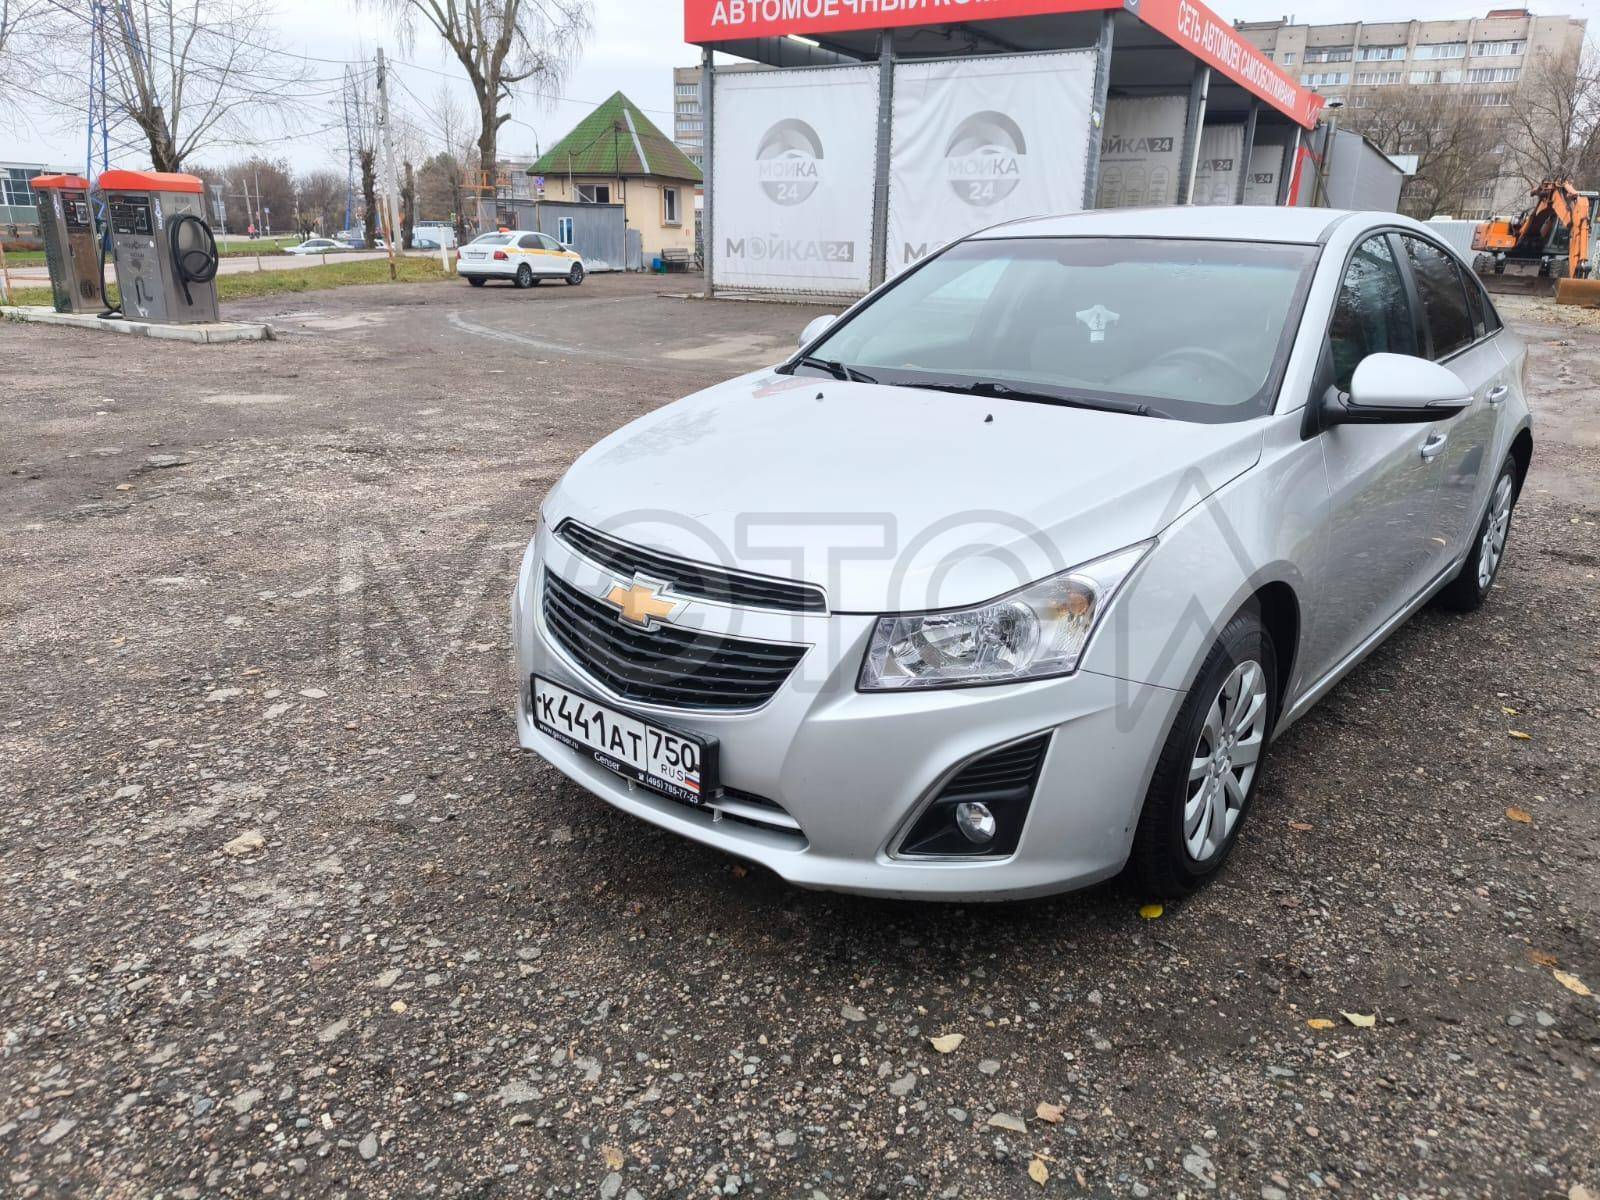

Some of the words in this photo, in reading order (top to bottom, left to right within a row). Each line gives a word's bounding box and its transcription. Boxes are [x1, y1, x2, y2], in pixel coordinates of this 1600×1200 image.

[1178, 0, 1200, 43] СЕТЬ
[1201, 20, 1241, 72] АВТОМОЕК
[1101, 135, 1148, 153] ОЙКА
[777, 183, 799, 200] 24
[969, 182, 995, 199] 24
[649, 729, 696, 772] 750
[646, 774, 664, 789] (495)
[661, 763, 684, 782] RUS
